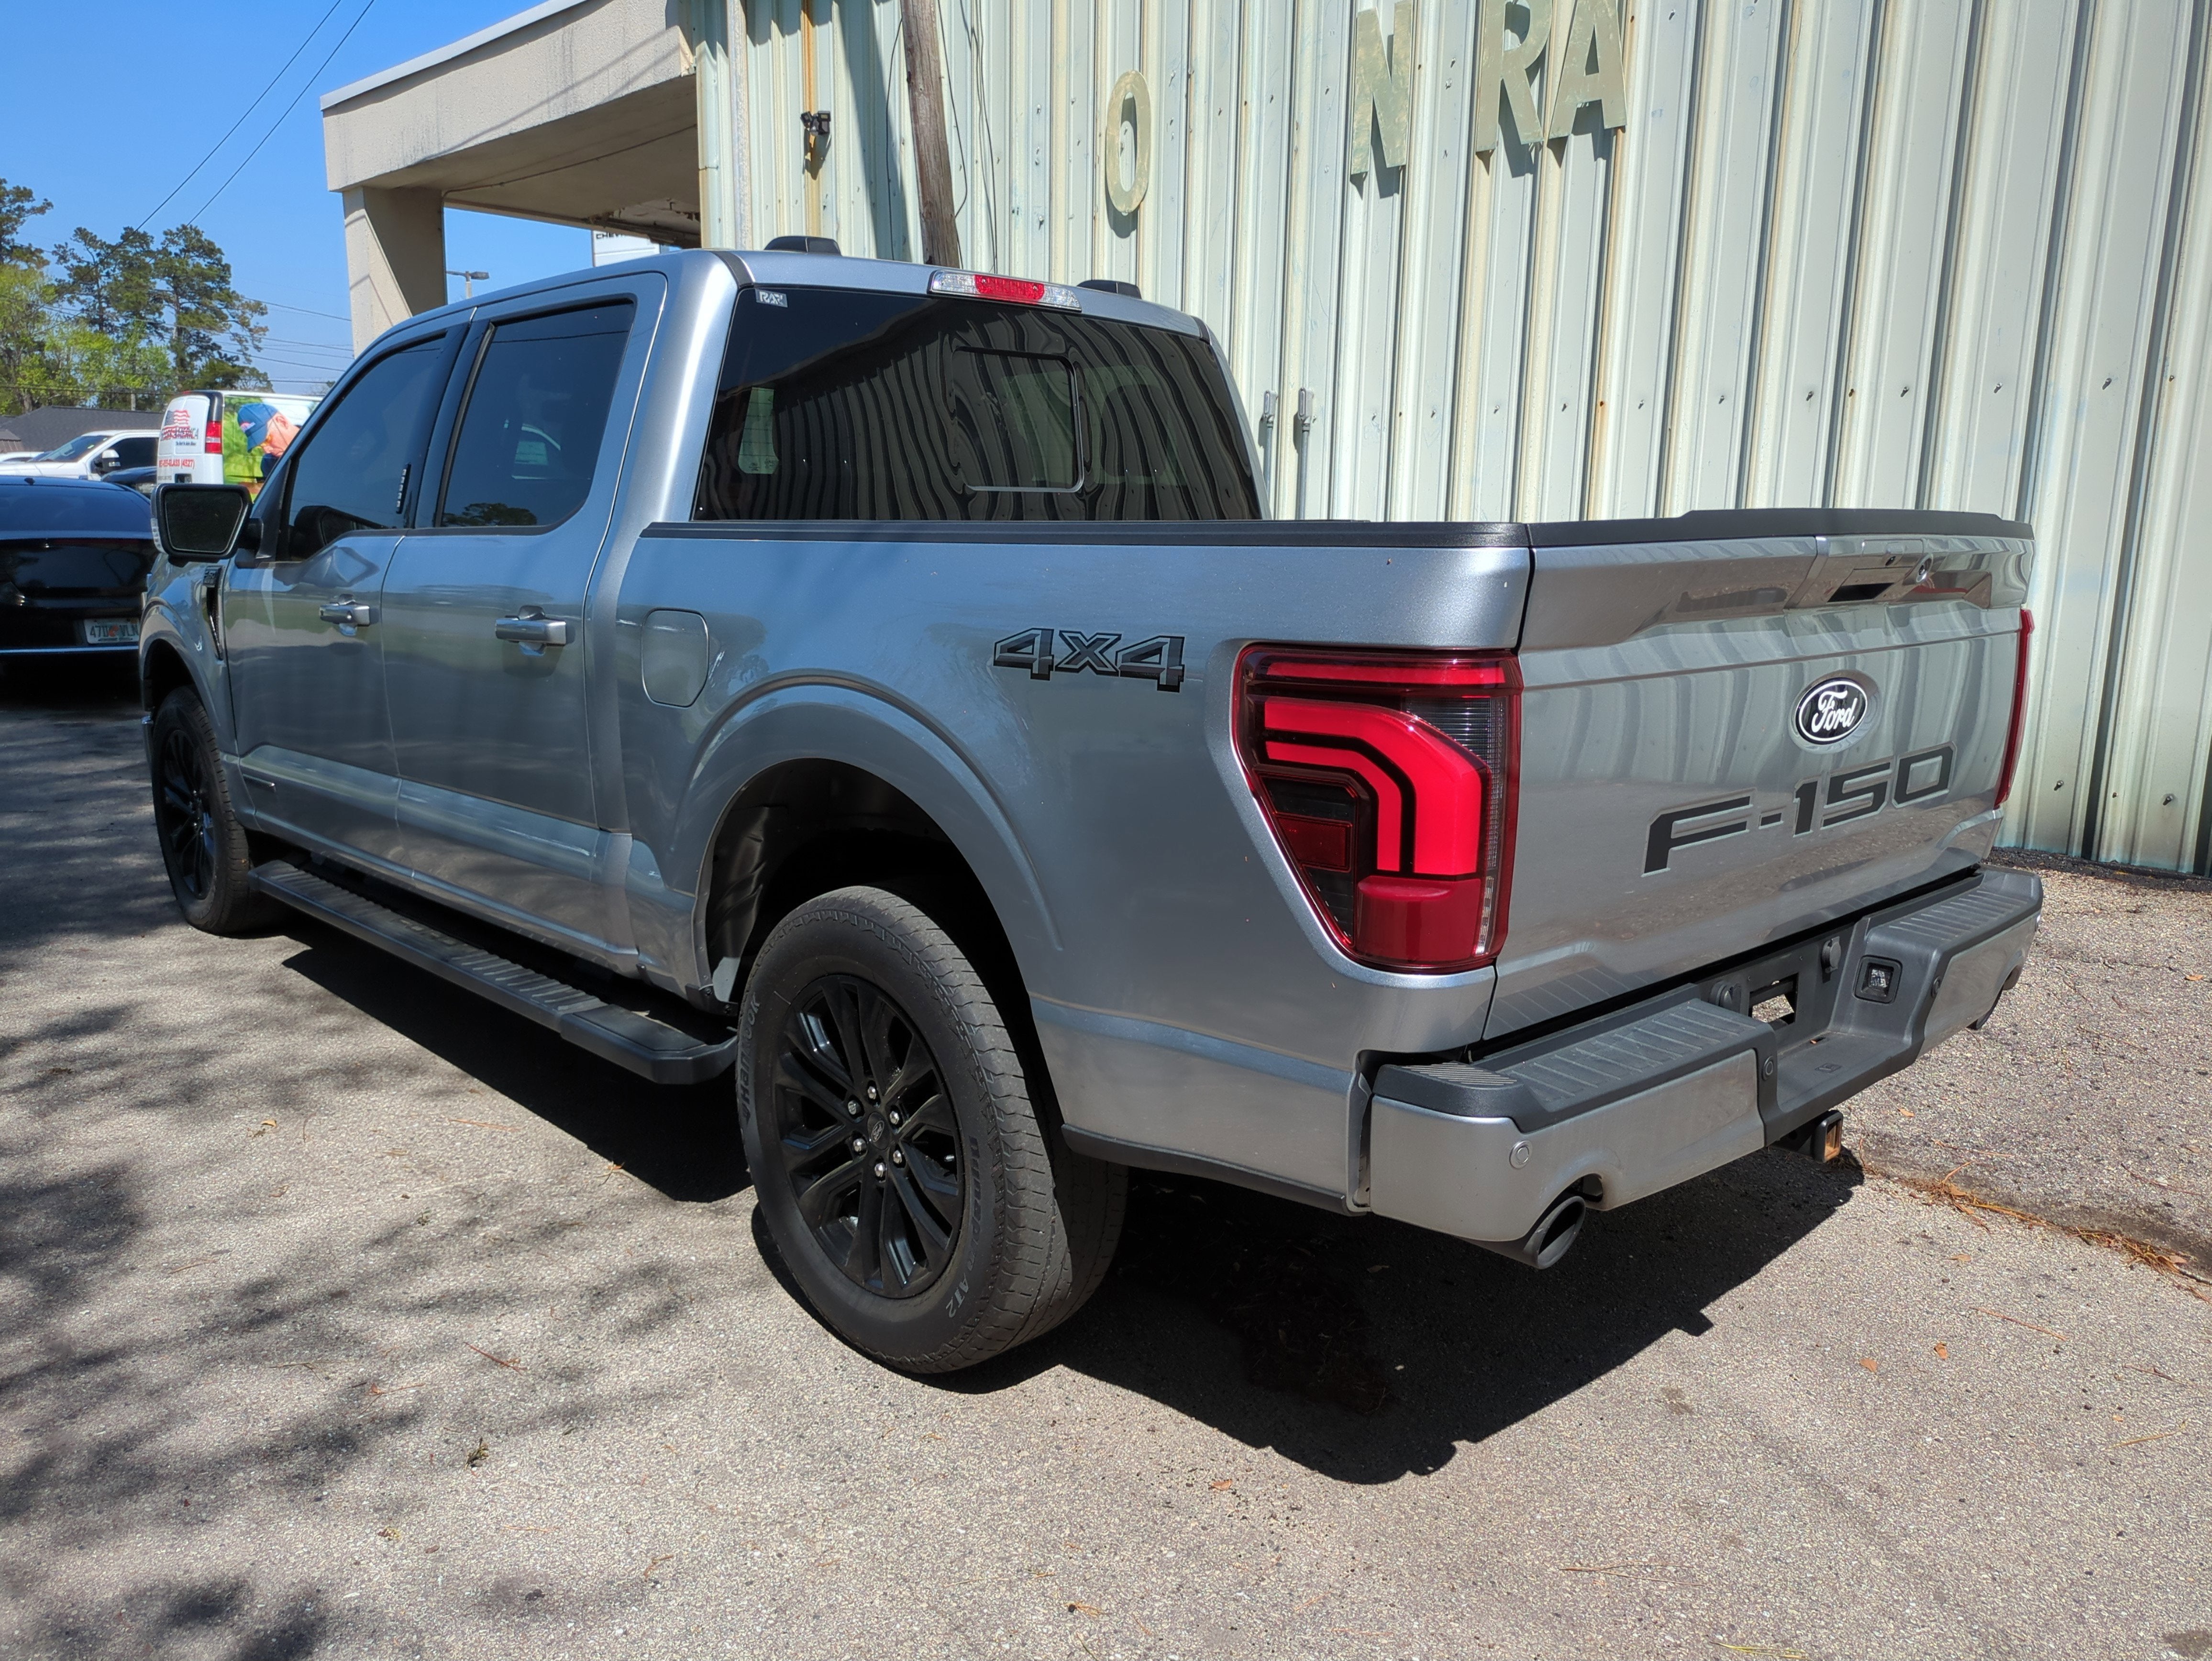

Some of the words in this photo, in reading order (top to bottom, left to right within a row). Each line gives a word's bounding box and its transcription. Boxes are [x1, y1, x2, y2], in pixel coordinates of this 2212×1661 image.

[1106, 70, 1151, 215] O
[1350, 0, 1414, 175] N
[1811, 689, 1858, 733] Ford
[1641, 742, 1958, 877] F-150
[946, 1273, 969, 1318] AT2
